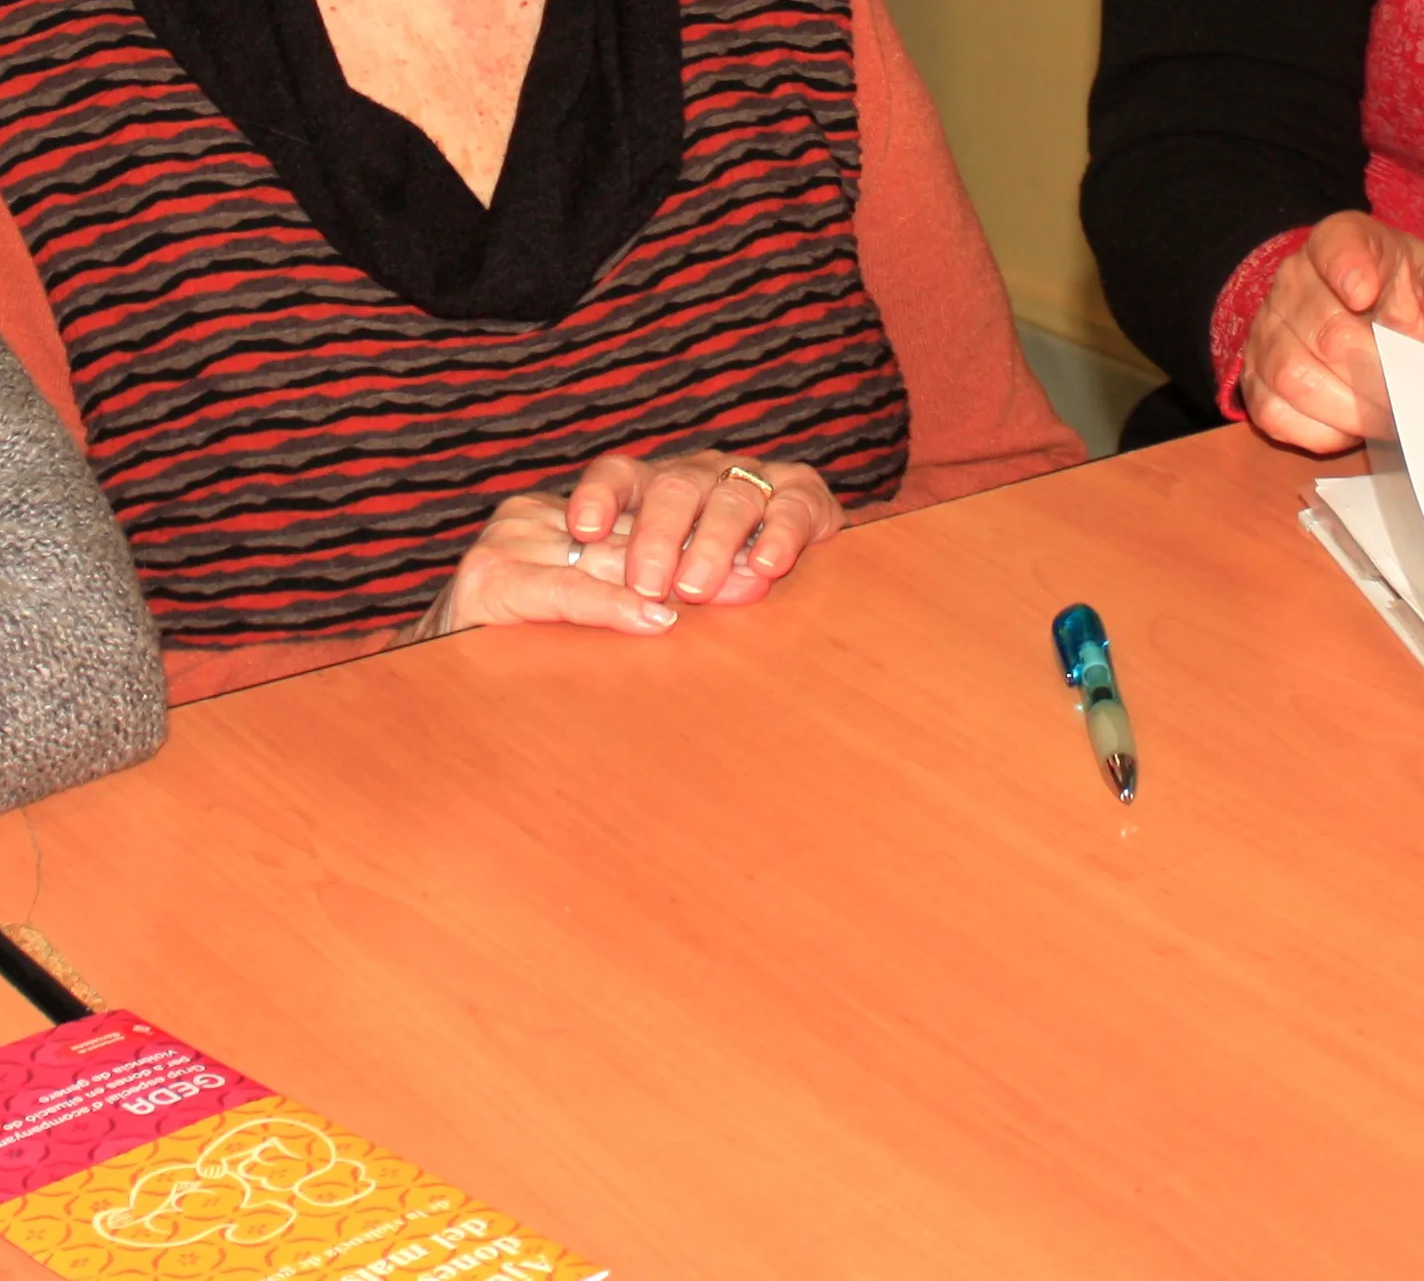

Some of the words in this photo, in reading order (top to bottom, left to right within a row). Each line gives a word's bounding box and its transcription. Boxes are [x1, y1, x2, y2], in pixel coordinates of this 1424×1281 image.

[153, 1064, 165, 1072] a
[167, 1054, 191, 1068] per
[91, 1071, 112, 1083] de
[167, 1064, 206, 1079] Grup
[106, 1068, 153, 1090] dones
[84, 1086, 106, 1098] en
[105, 1076, 166, 1105] especial
[122, 1073, 225, 1116] GEDA
[24, 1095, 84, 1123] situació
[2, 1119, 24, 1131] de
[427, 1199, 451, 1212] de
[405, 1209, 428, 1220] la
[429, 1218, 488, 1250] del
[298, 1255, 323, 1270] de
